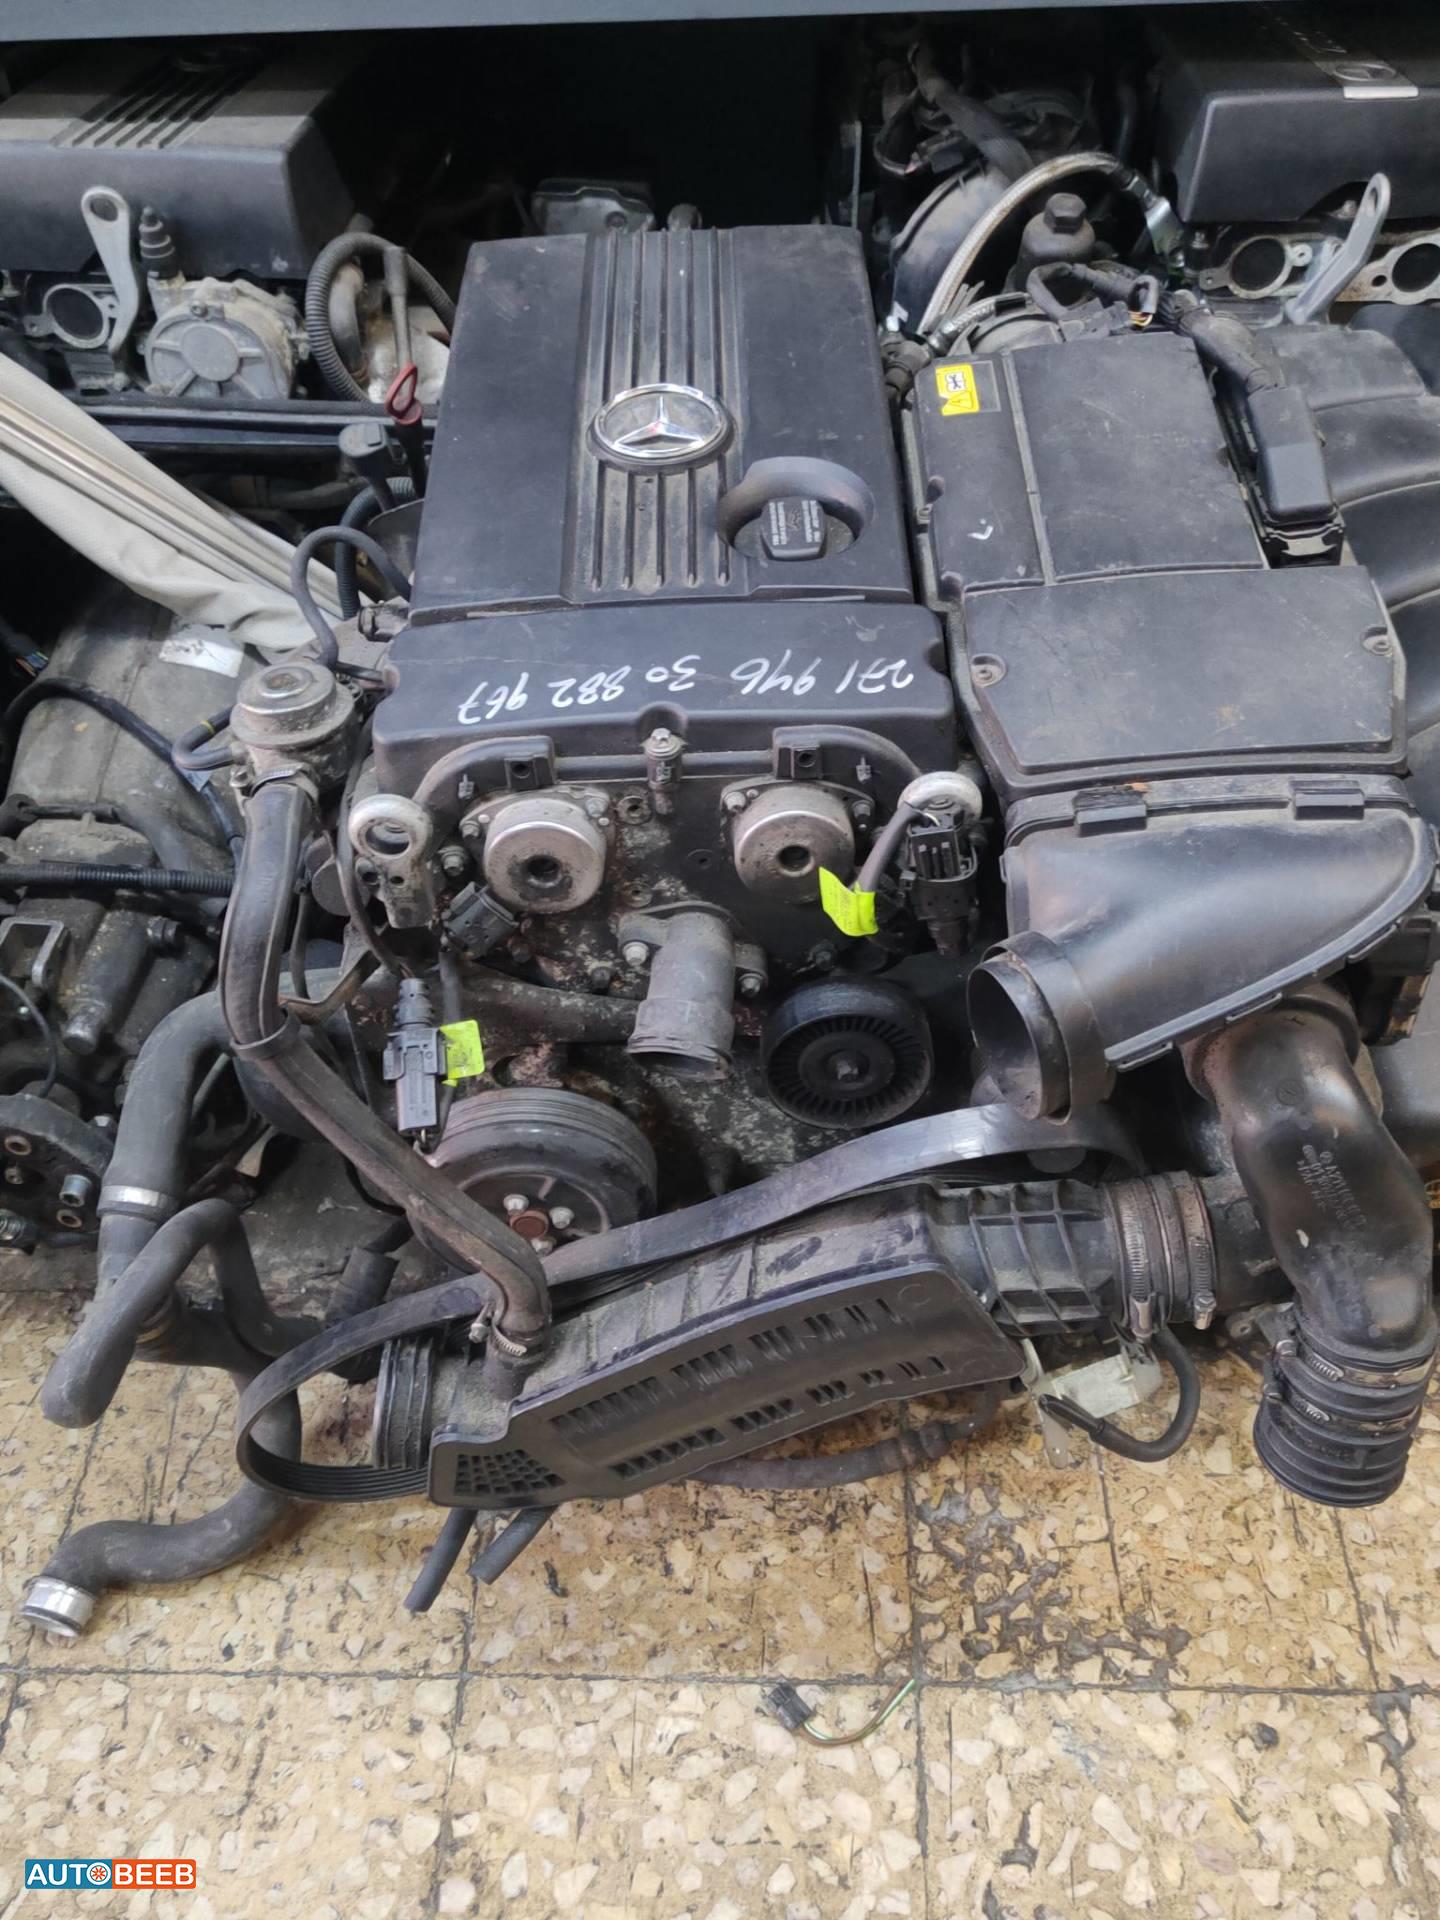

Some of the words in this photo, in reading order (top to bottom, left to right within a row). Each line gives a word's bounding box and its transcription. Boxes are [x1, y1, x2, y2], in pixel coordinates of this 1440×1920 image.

[547, 665, 632, 708] 882
[646, 654, 701, 692] 30
[730, 649, 822, 695] 946
[835, 658, 915, 694] 271
[458, 672, 528, 724] 967
